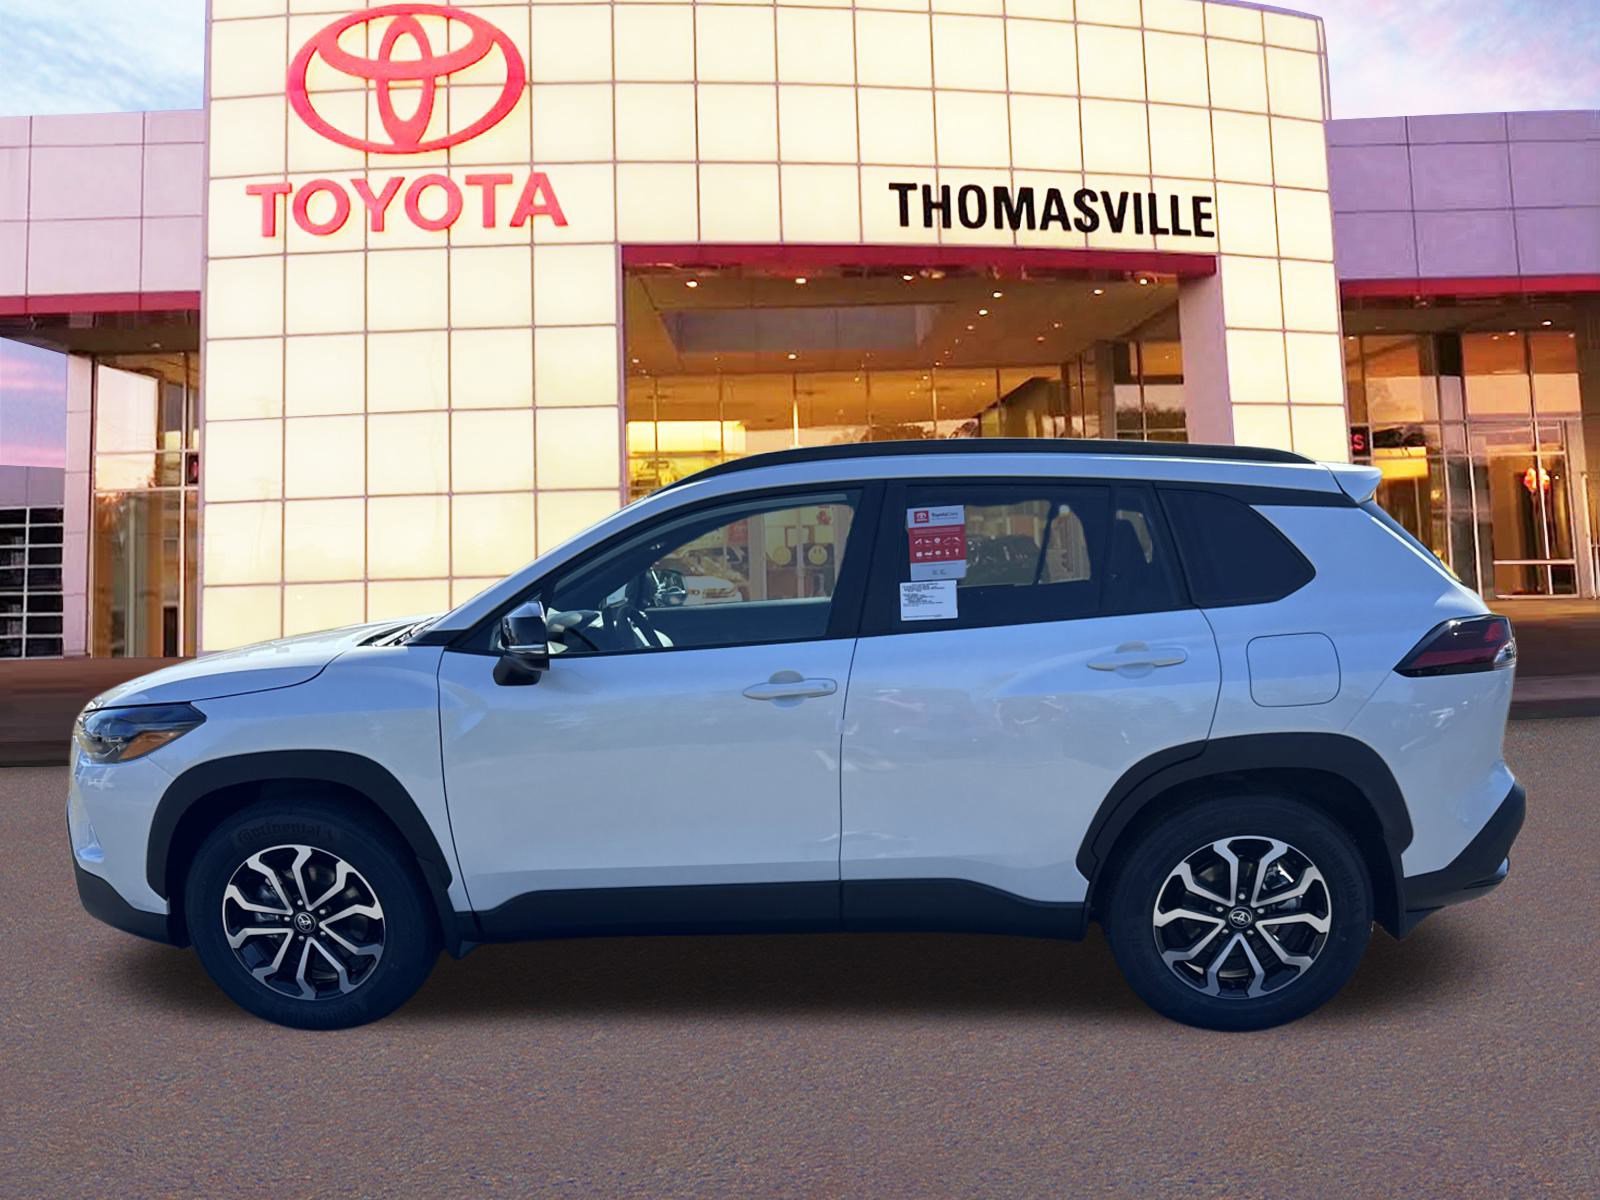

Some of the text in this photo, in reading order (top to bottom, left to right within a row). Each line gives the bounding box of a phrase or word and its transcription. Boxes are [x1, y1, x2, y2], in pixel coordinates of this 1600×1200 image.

[246, 171, 568, 237] TOYOTA
[888, 182, 1215, 238] THOMASVILLE
[239, 821, 321, 841] Continental
